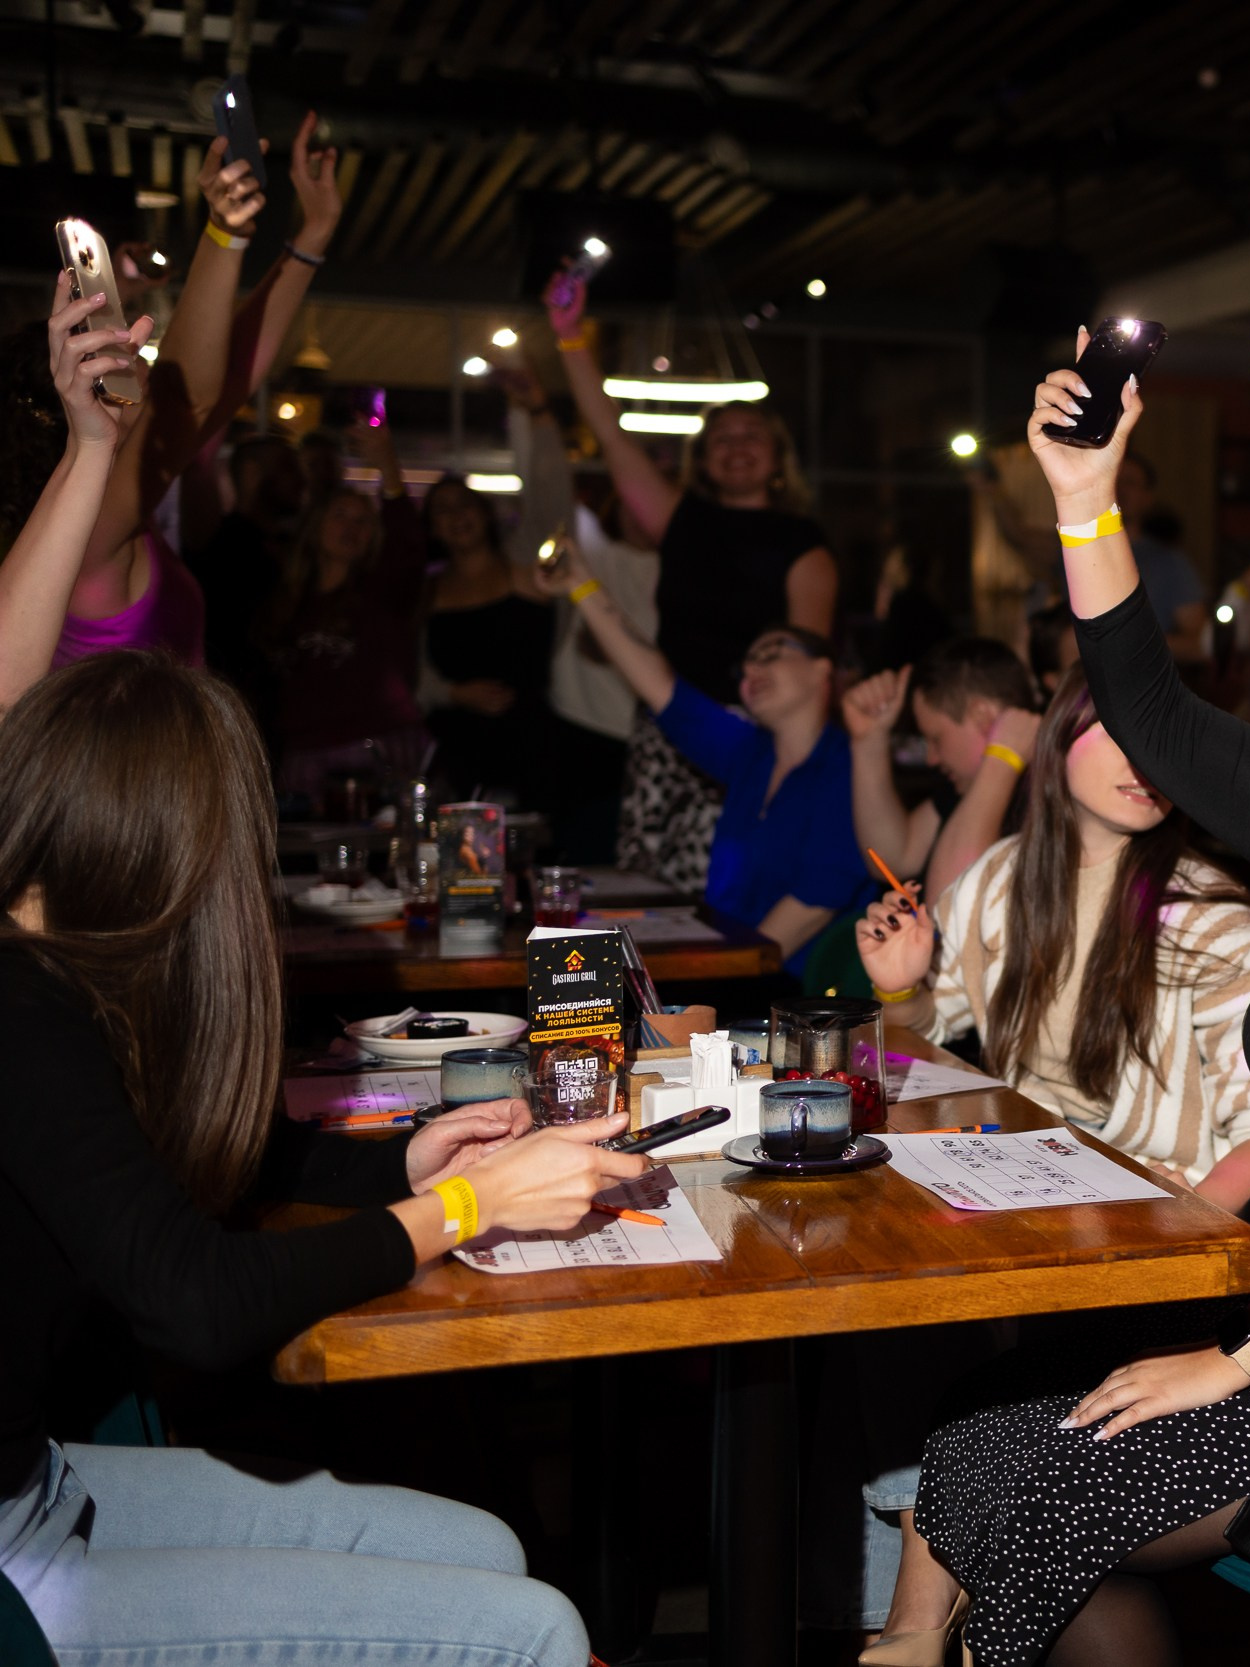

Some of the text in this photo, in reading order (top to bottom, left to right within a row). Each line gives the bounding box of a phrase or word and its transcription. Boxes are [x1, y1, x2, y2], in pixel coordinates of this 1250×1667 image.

[552, 970, 597, 986] GASTROLI GRILL
[538, 998, 612, 1013] ПРИСОЕДИНЯЙСЯ
[543, 1010, 575, 1020] НАШЕЙ
[576, 1006, 615, 1017] СИСТЕМЕ
[547, 1015, 604, 1027] ЛОЯЛЬНОСТИ
[531, 1031, 564, 1040] СПИСАНИЕ
[591, 1025, 620, 1034] БОНУСОВ
[941, 1140, 957, 1148] 90
[452, 1182, 474, 1224] GASTROLI
